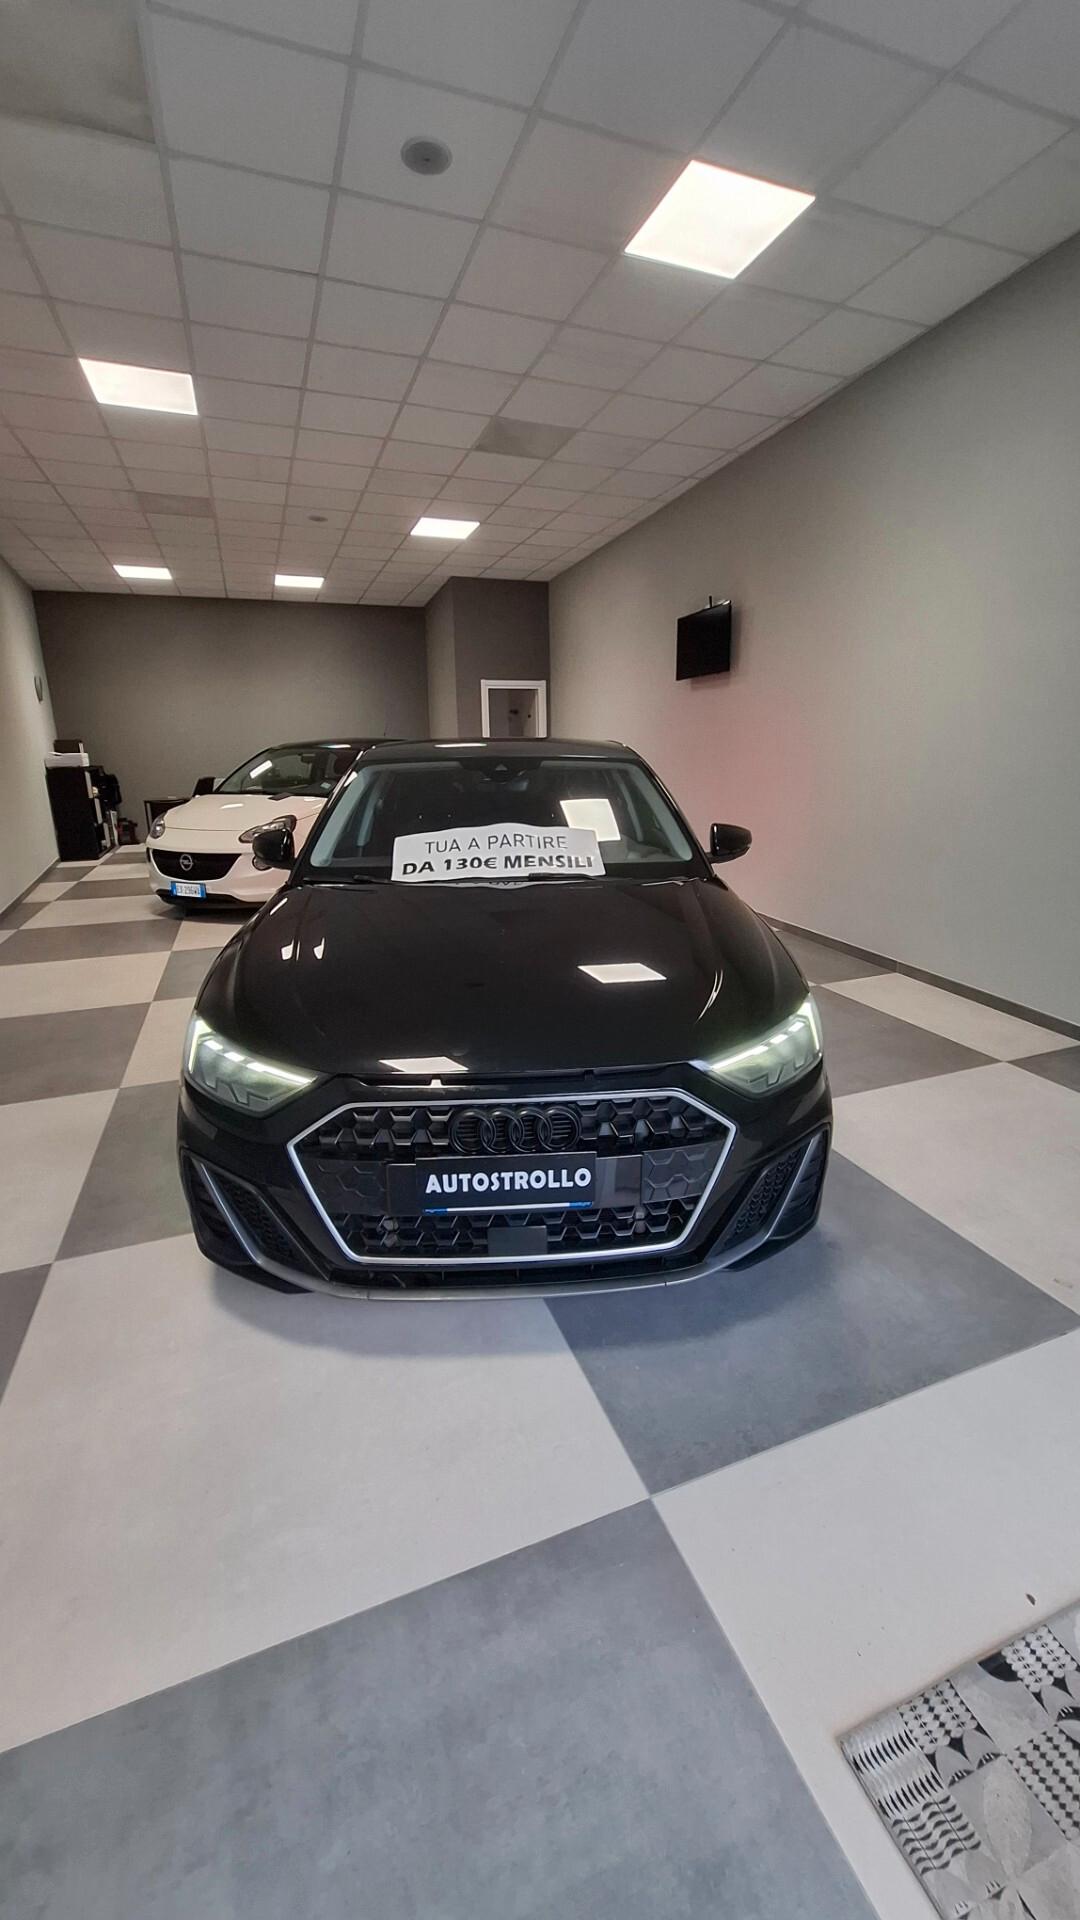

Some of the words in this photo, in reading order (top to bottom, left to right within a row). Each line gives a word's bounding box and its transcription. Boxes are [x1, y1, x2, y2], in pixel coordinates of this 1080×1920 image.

[425, 838, 461, 854] TUA
[467, 837, 481, 850] A
[487, 833, 568, 850] PARTIRE
[402, 860, 435, 876] DA
[444, 856, 498, 871] 130€
[503, 854, 594, 869] MENSILI
[425, 1167, 592, 1194] AUTOSTROLLO
